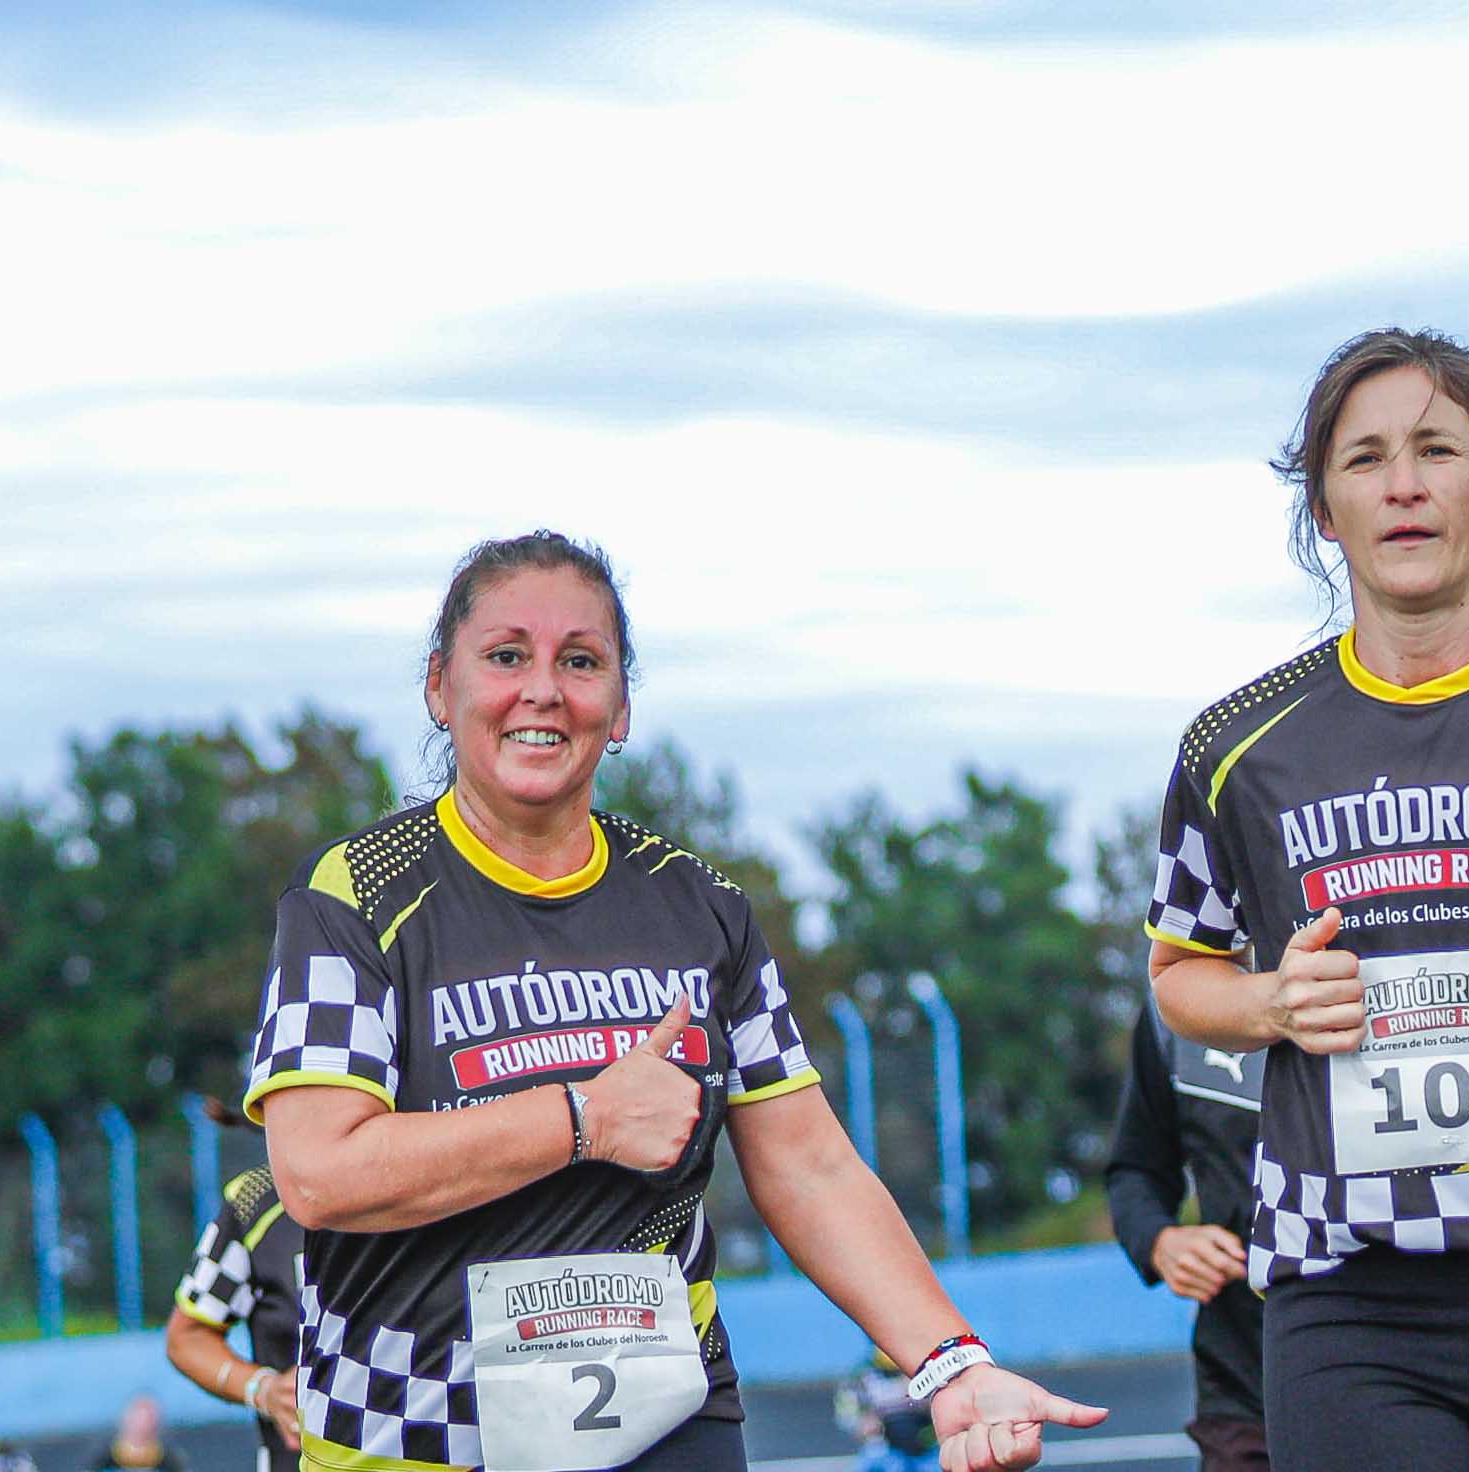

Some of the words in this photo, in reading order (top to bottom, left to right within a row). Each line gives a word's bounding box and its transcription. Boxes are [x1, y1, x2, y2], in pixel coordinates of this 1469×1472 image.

[1323, 853, 1443, 902] RUNNING
[1363, 908, 1384, 926] de
[1384, 905, 1409, 924] los
[1412, 902, 1469, 923] Clubes
[1387, 1009, 1457, 1035] RUNNING
[482, 1031, 607, 1080] RUNNING
[1372, 1040, 1408, 1051] Carrera
[1409, 1037, 1422, 1048] de
[1423, 1035, 1437, 1047] los
[505, 1268, 664, 1319] AUTÓDROMO
[533, 1309, 603, 1337] RUNNING
[606, 1308, 644, 1328] RACE
[505, 1343, 517, 1353] La
[518, 1342, 554, 1352] Carrera
[556, 1340, 569, 1350] de
[570, 1338, 585, 1349] los
[586, 1336, 618, 1347] Clubes
[620, 1333, 634, 1344] del
[571, 1362, 622, 1432] 2
